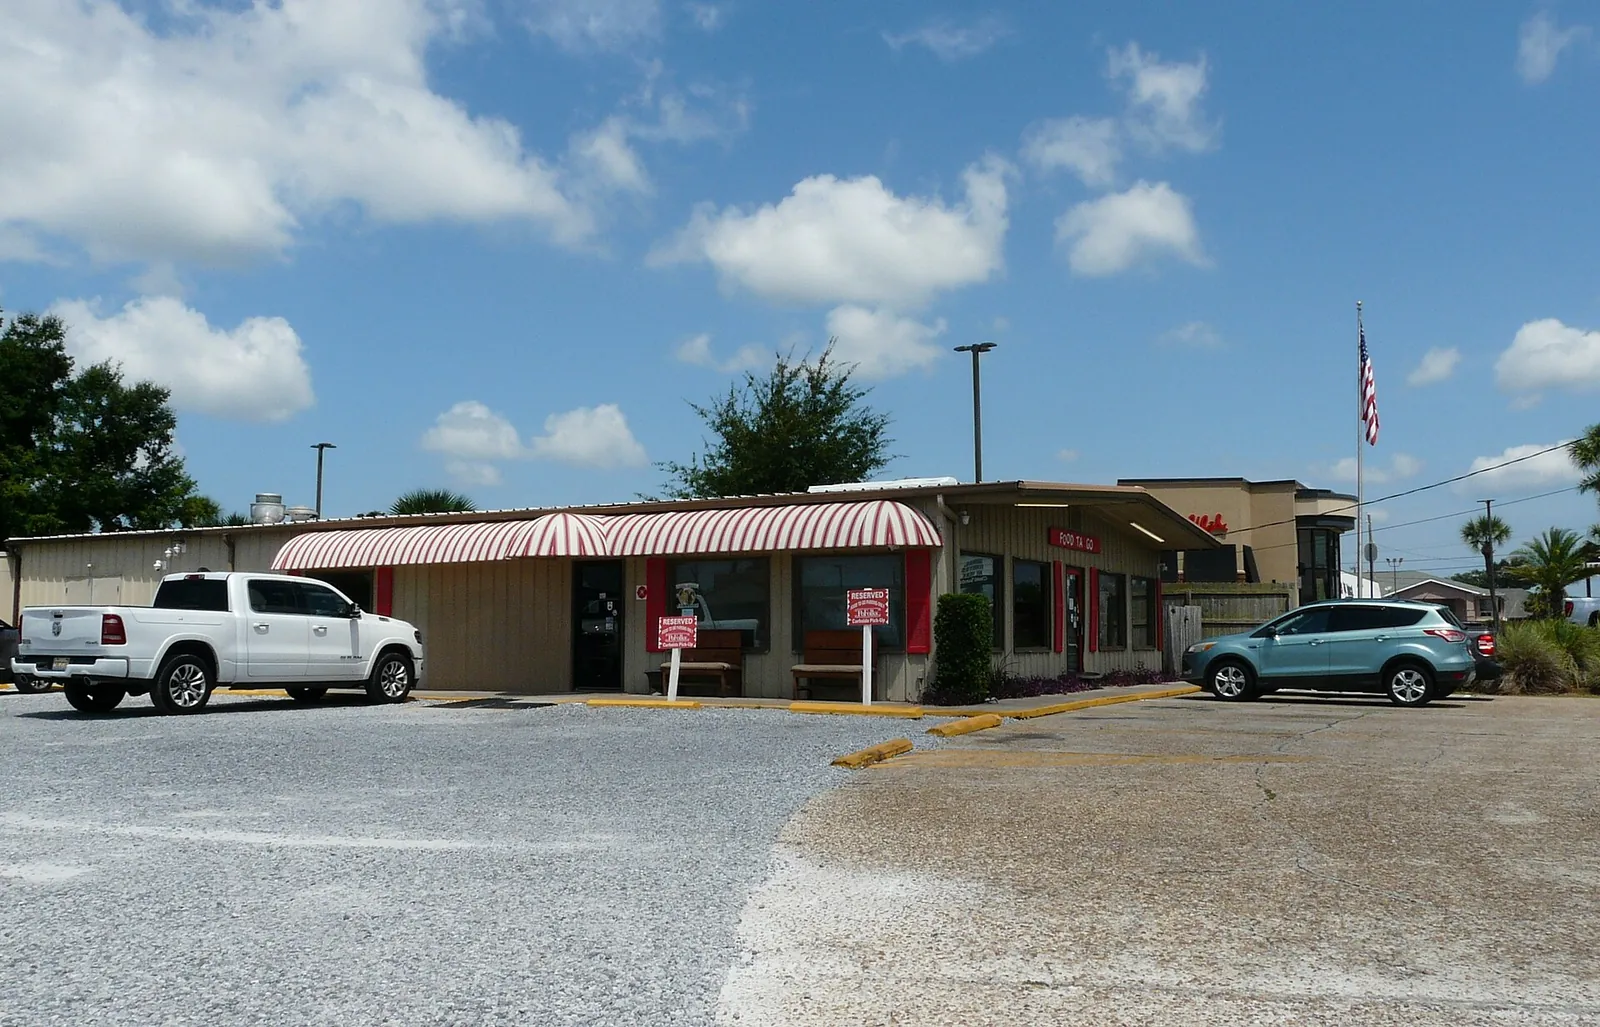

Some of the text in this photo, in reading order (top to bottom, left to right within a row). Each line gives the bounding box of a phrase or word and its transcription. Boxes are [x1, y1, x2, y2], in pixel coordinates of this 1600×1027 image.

[1060, 532, 1074, 546] FOOD
[1086, 537, 1094, 551] GO
[851, 591, 884, 600] RESERVED
[662, 618, 694, 626] RESERVED
